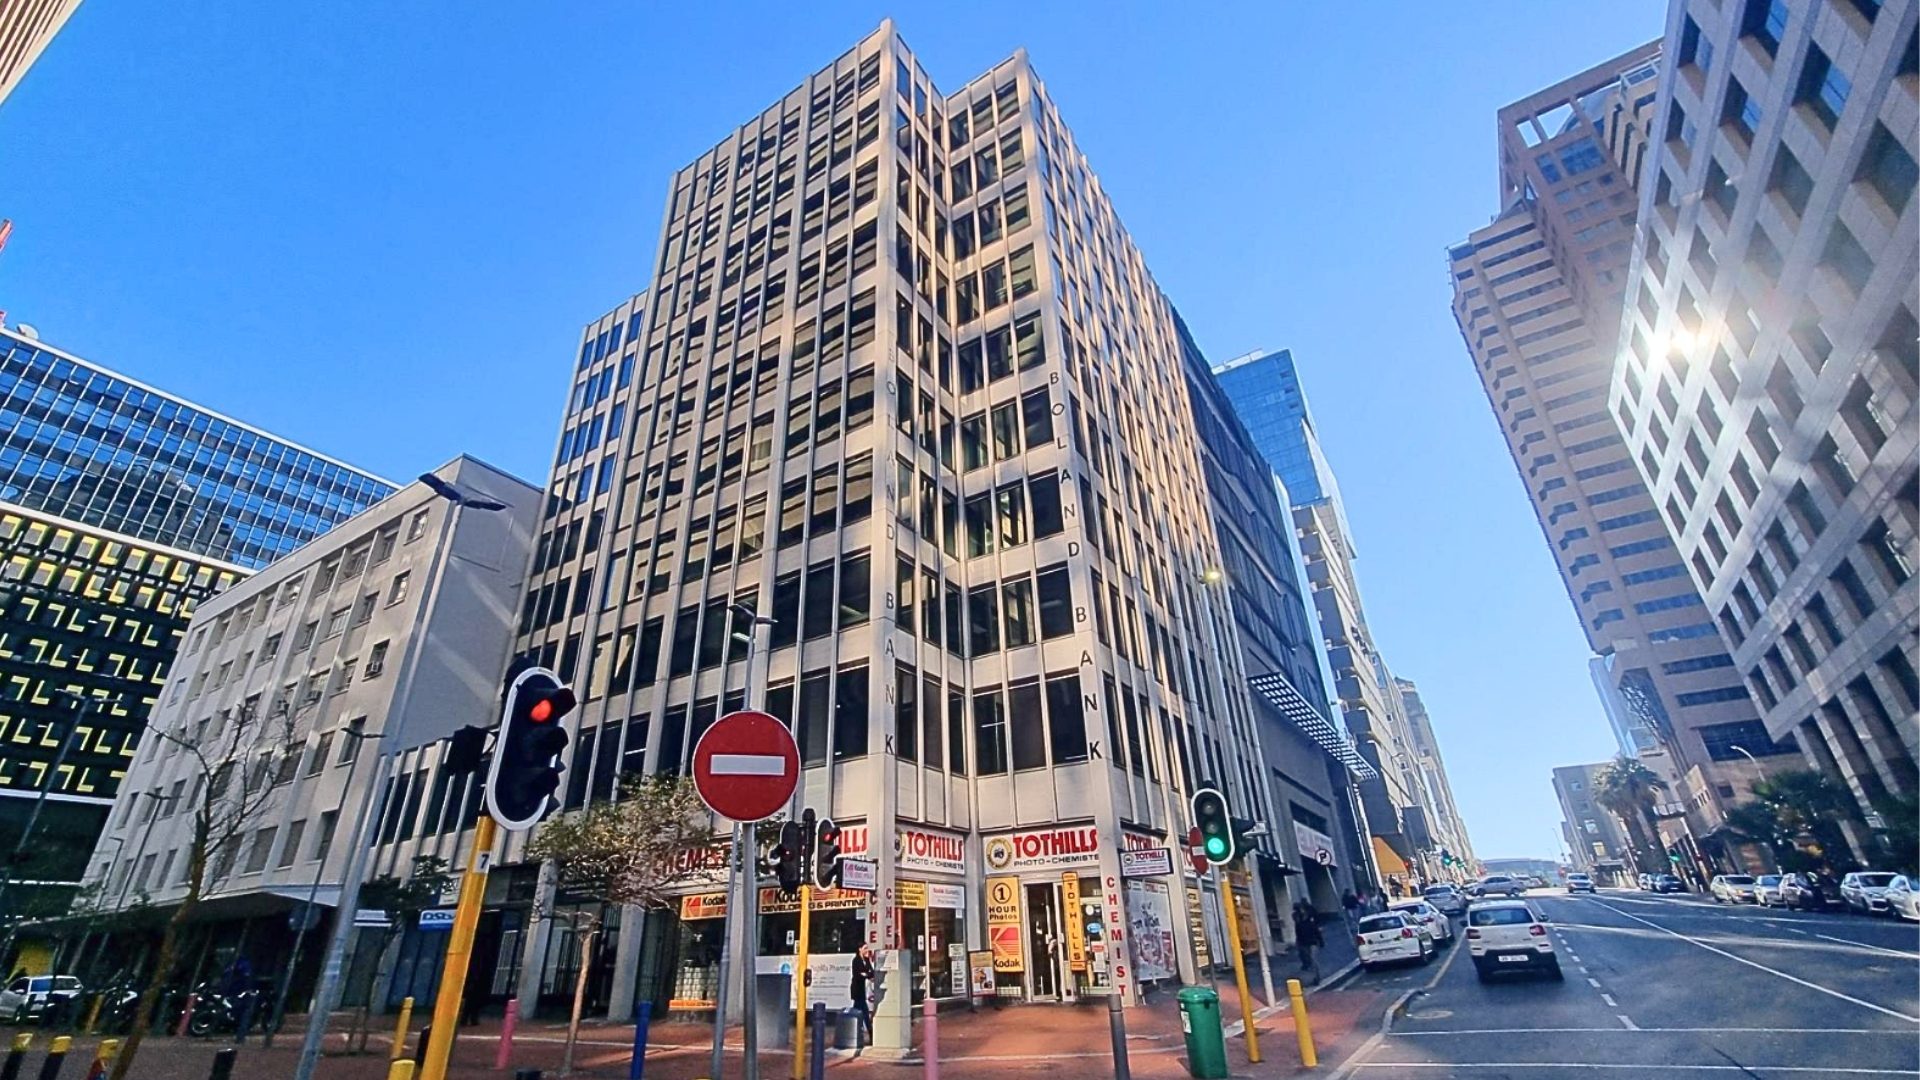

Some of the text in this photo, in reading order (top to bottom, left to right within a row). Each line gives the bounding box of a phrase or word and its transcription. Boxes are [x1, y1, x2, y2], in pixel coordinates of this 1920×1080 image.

[1050, 371, 1103, 760] BOLAND BANK
[884, 592, 896, 754] BANK
[906, 831, 964, 861] TOTHILLS
[1013, 829, 1098, 858] TOTHILLS
[480, 853, 490, 869] 7
[1013, 858, 1046, 867] PHOTO
[1135, 850, 1165, 860] TOTHILLS
[702, 895, 727, 906] Kodak
[998, 887, 1006, 901] 1
[761, 902, 816, 913] DEVELOPG
[988, 905, 1017, 914] HOUR
[1067, 882, 1082, 960] TOTHILLS
[1106, 877, 1127, 996] CHEMIST
[993, 958, 1021, 969] Kodak
